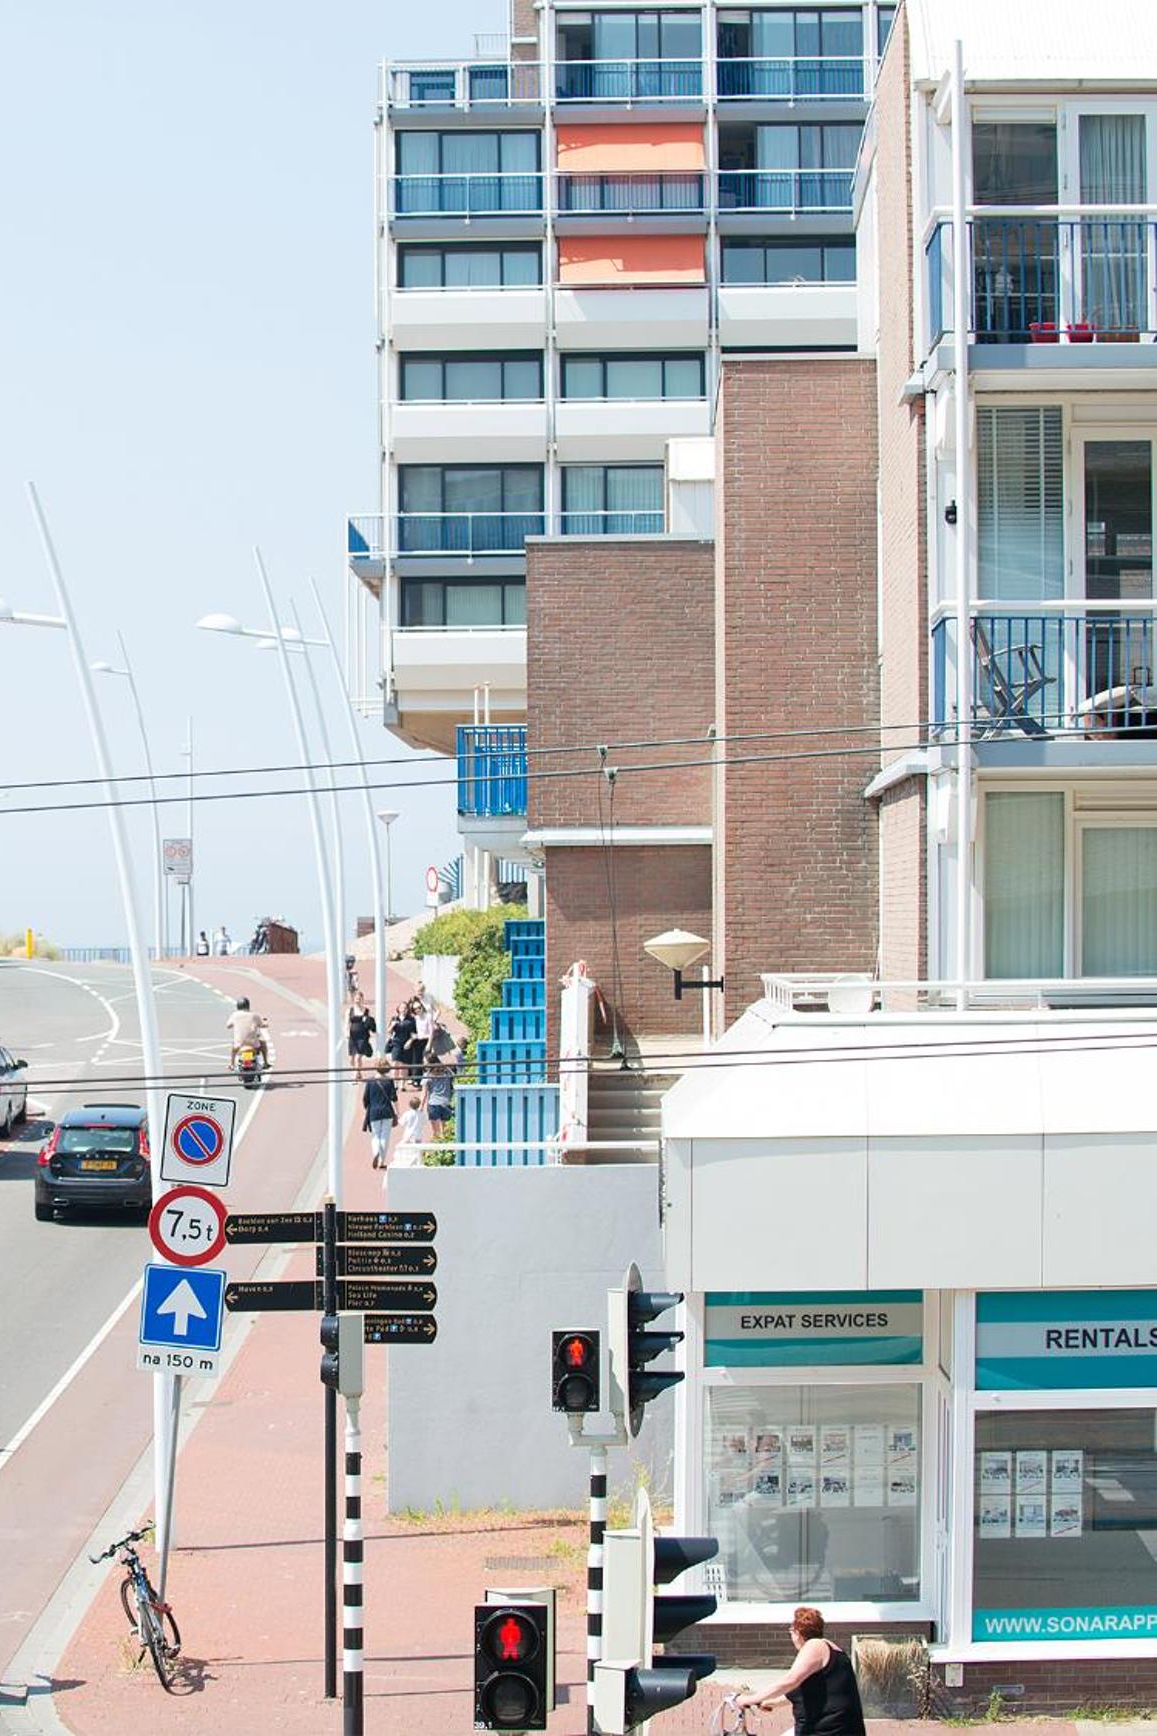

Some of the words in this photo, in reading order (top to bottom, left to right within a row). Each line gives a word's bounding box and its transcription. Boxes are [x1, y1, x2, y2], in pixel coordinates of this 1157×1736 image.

[187, 1101, 215, 1112] ZONE
[166, 1209, 201, 1241] 7,5
[206, 1223, 214, 1242] t
[740, 1314, 796, 1329] EXPAT
[801, 1312, 889, 1328] SERVICES
[142, 1354, 161, 1366] na
[167, 1354, 193, 1368] 150
[199, 1359, 214, 1371] m
[985, 1614, 1157, 1633] WWW.SONARAPP
